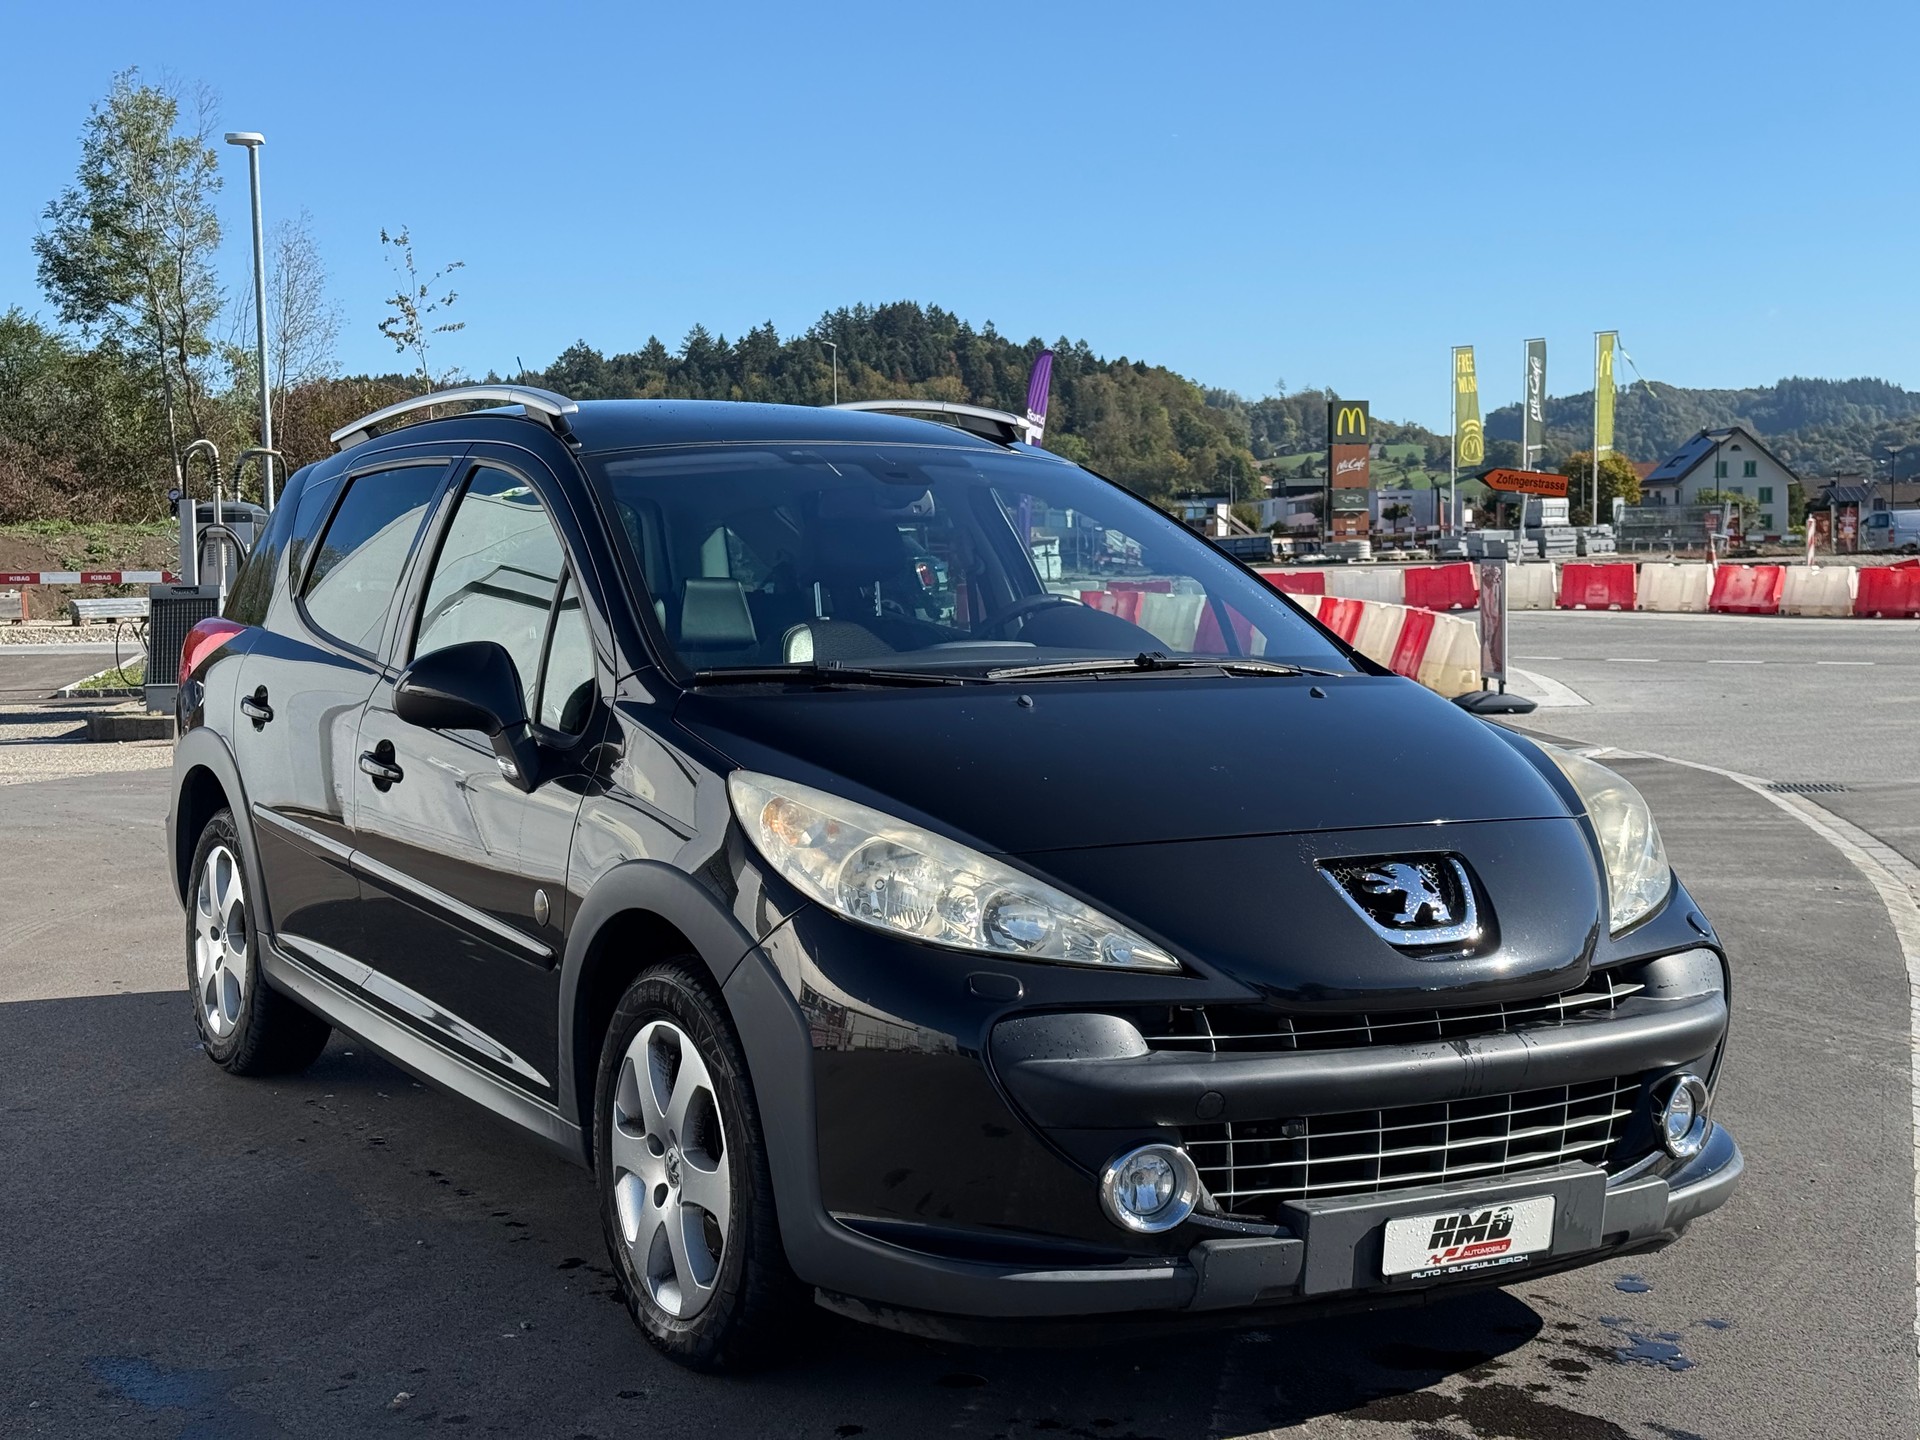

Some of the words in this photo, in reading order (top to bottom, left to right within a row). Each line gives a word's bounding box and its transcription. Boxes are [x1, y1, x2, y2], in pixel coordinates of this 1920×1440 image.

[1457, 353, 1474, 373] FREE
[1496, 473, 1566, 490] Zofingerstrasse
[1463, 1244, 1507, 1256] AUTOMOBILE
[1411, 1268, 1441, 1280] AUTO
